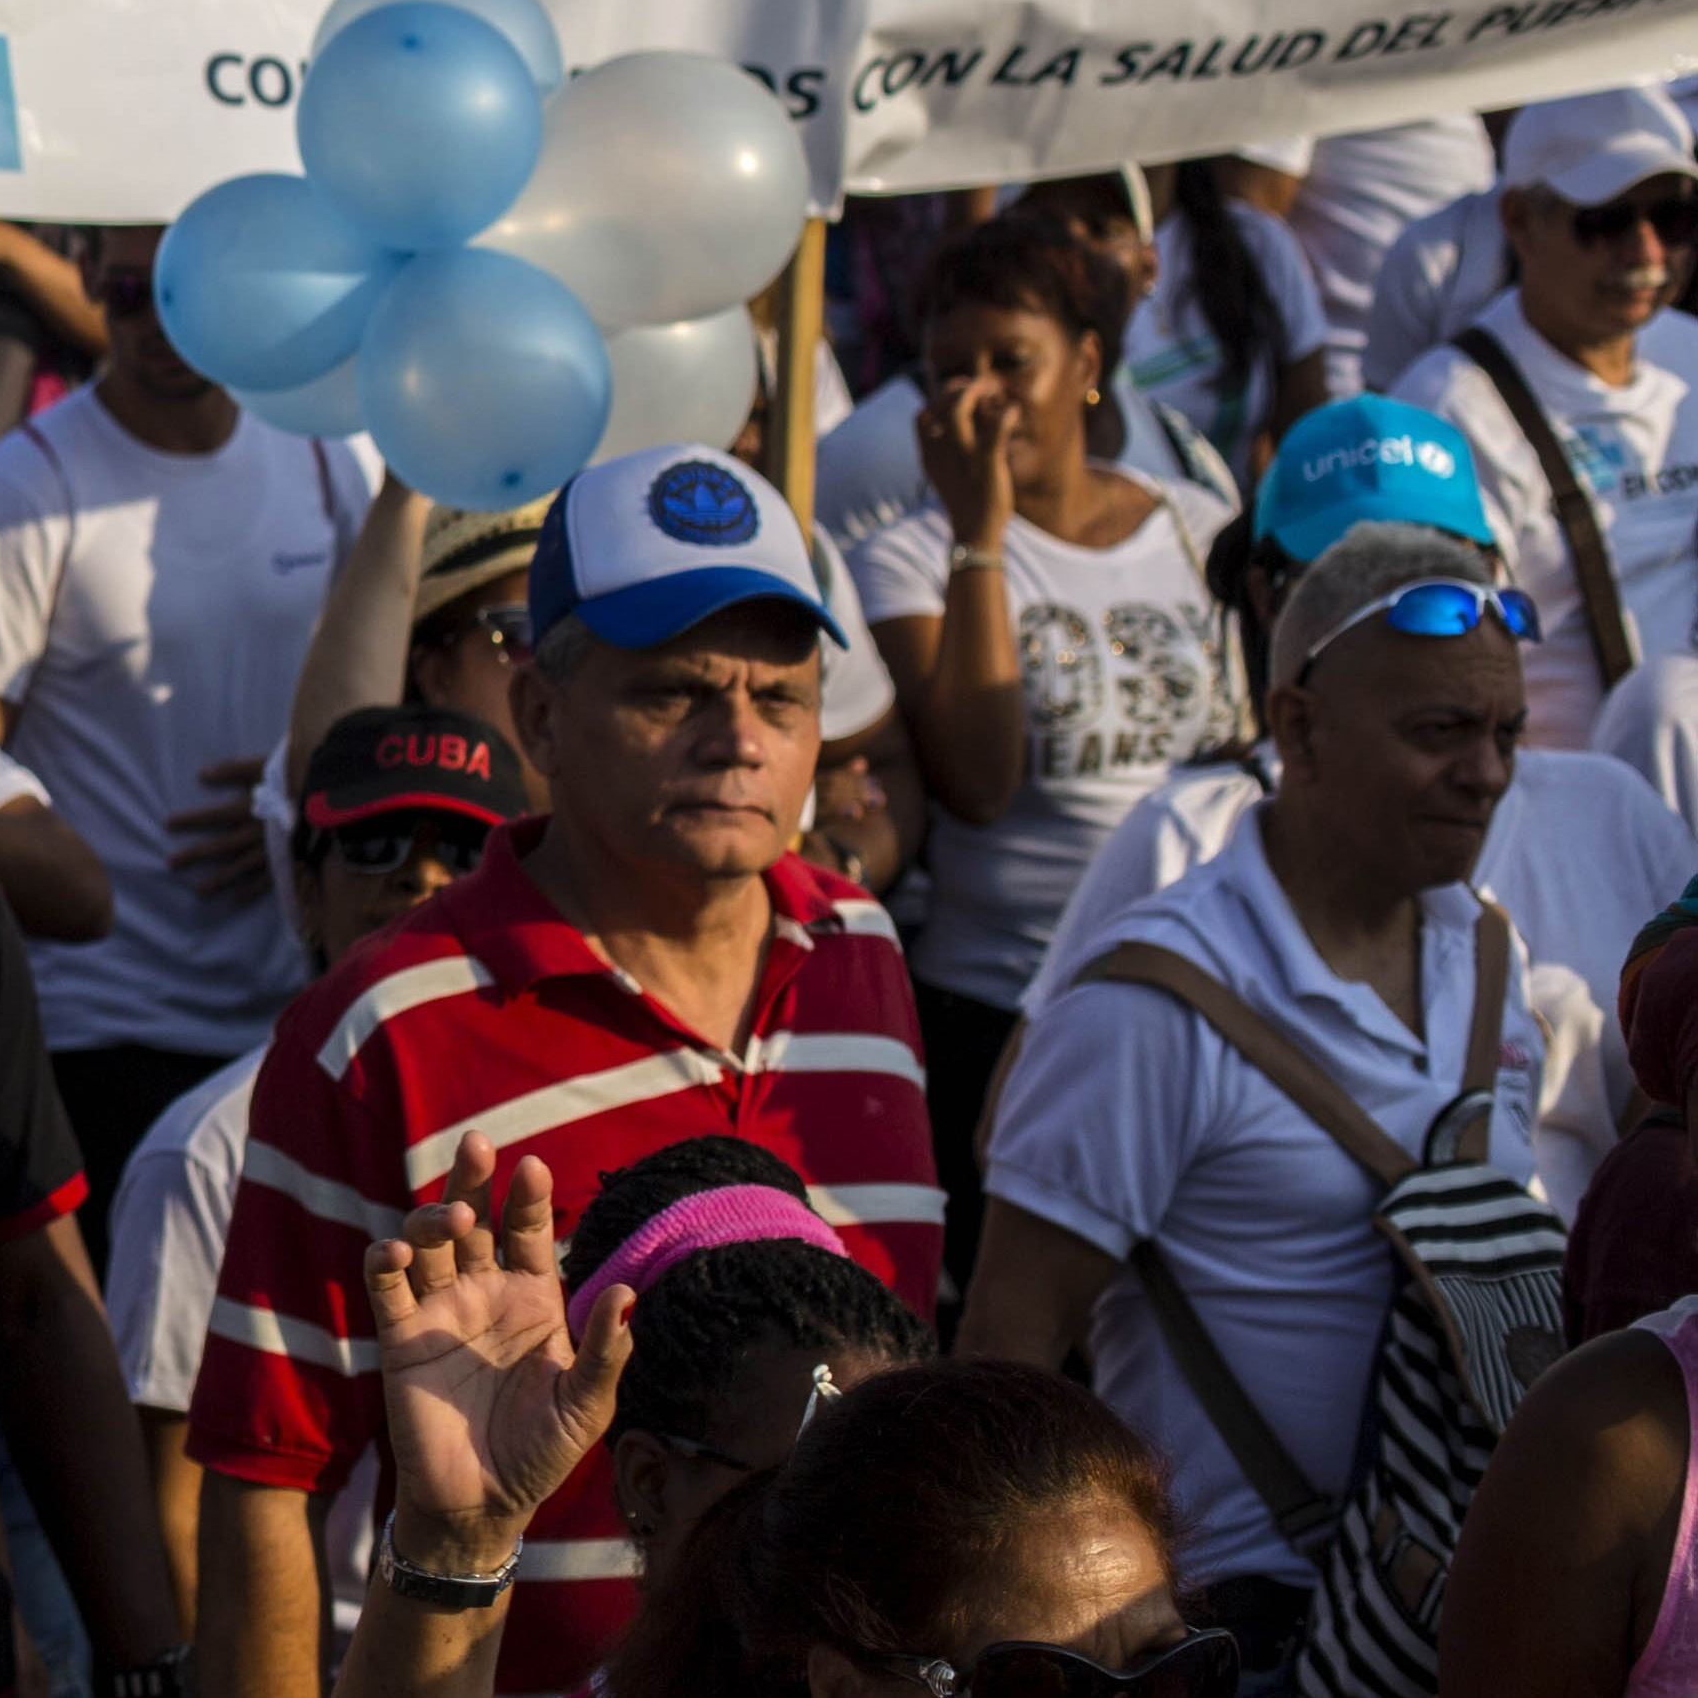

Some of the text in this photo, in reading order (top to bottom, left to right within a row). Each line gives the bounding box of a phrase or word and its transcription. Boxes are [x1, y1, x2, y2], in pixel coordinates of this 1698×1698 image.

[989, 42, 1083, 88] LA
[1098, 28, 1327, 88] SALUD
[1332, 8, 1449, 64] DEL
[375, 733, 491, 783] CUBA
